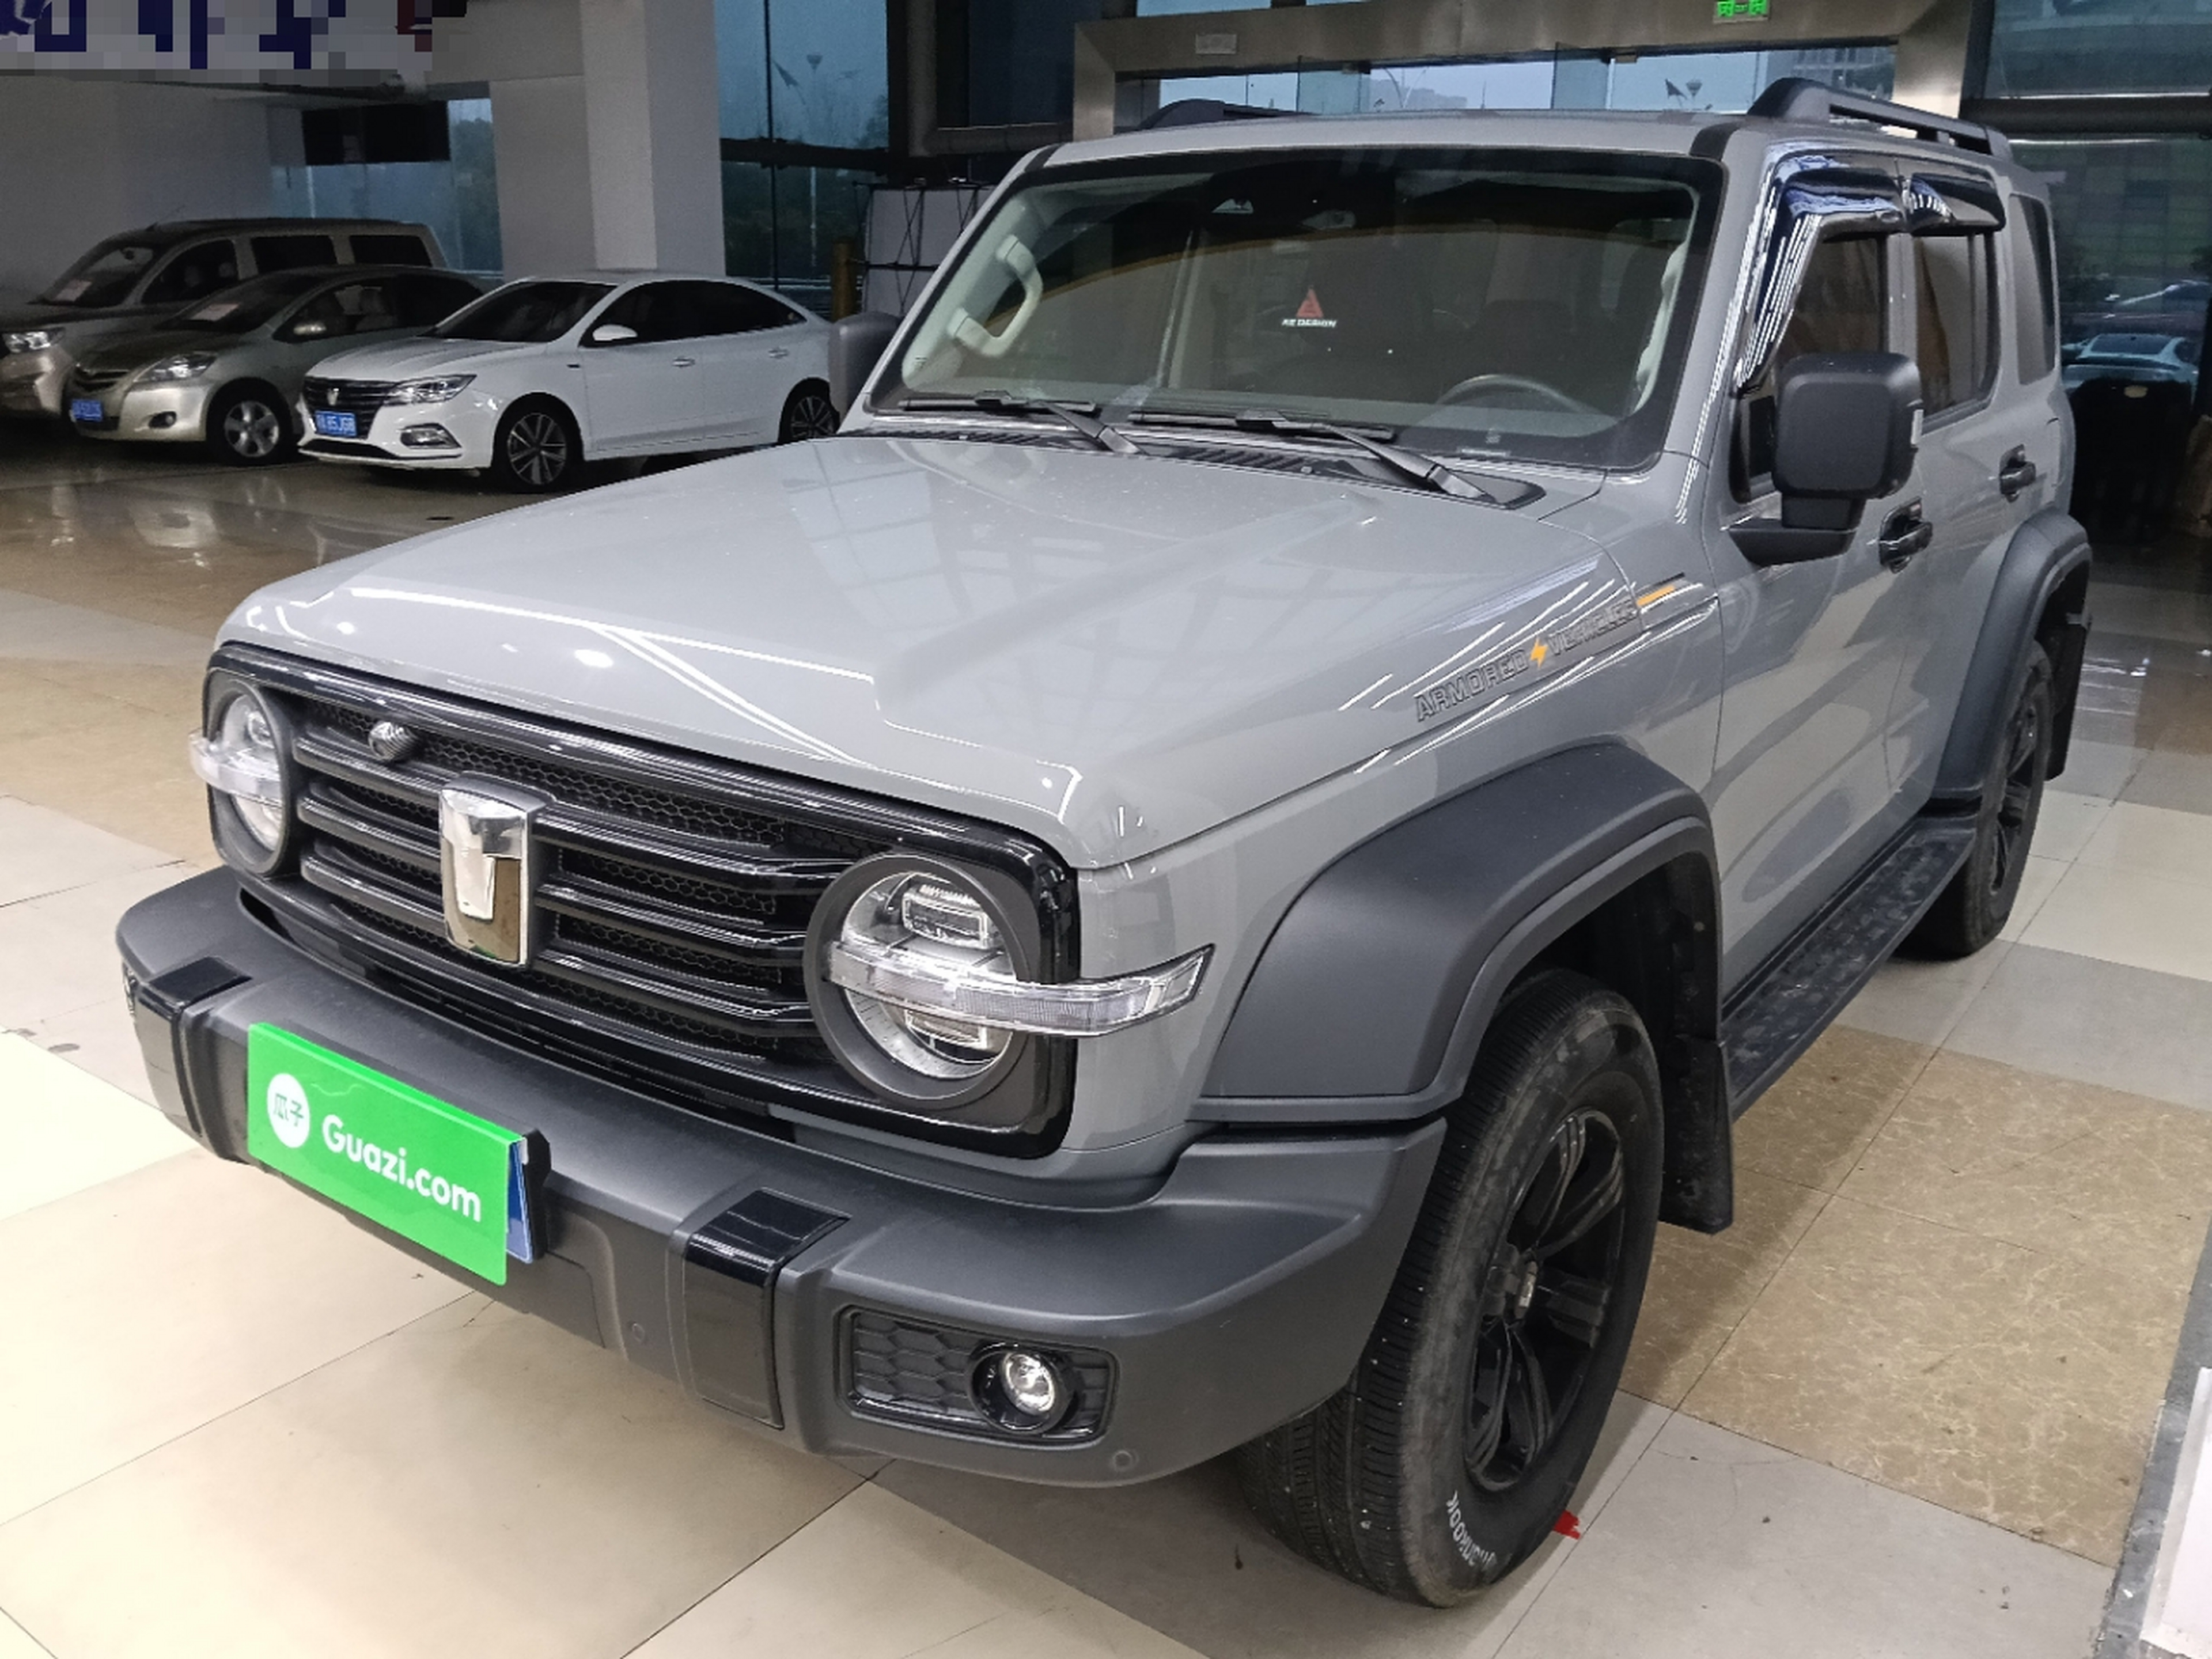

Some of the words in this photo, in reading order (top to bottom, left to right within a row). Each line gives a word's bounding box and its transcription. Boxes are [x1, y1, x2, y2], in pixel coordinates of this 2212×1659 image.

[1414, 649, 1530, 722] ARMORED
[272, 1092, 305, 1127] 瓜子
[322, 1114, 481, 1222] Guazi.com
